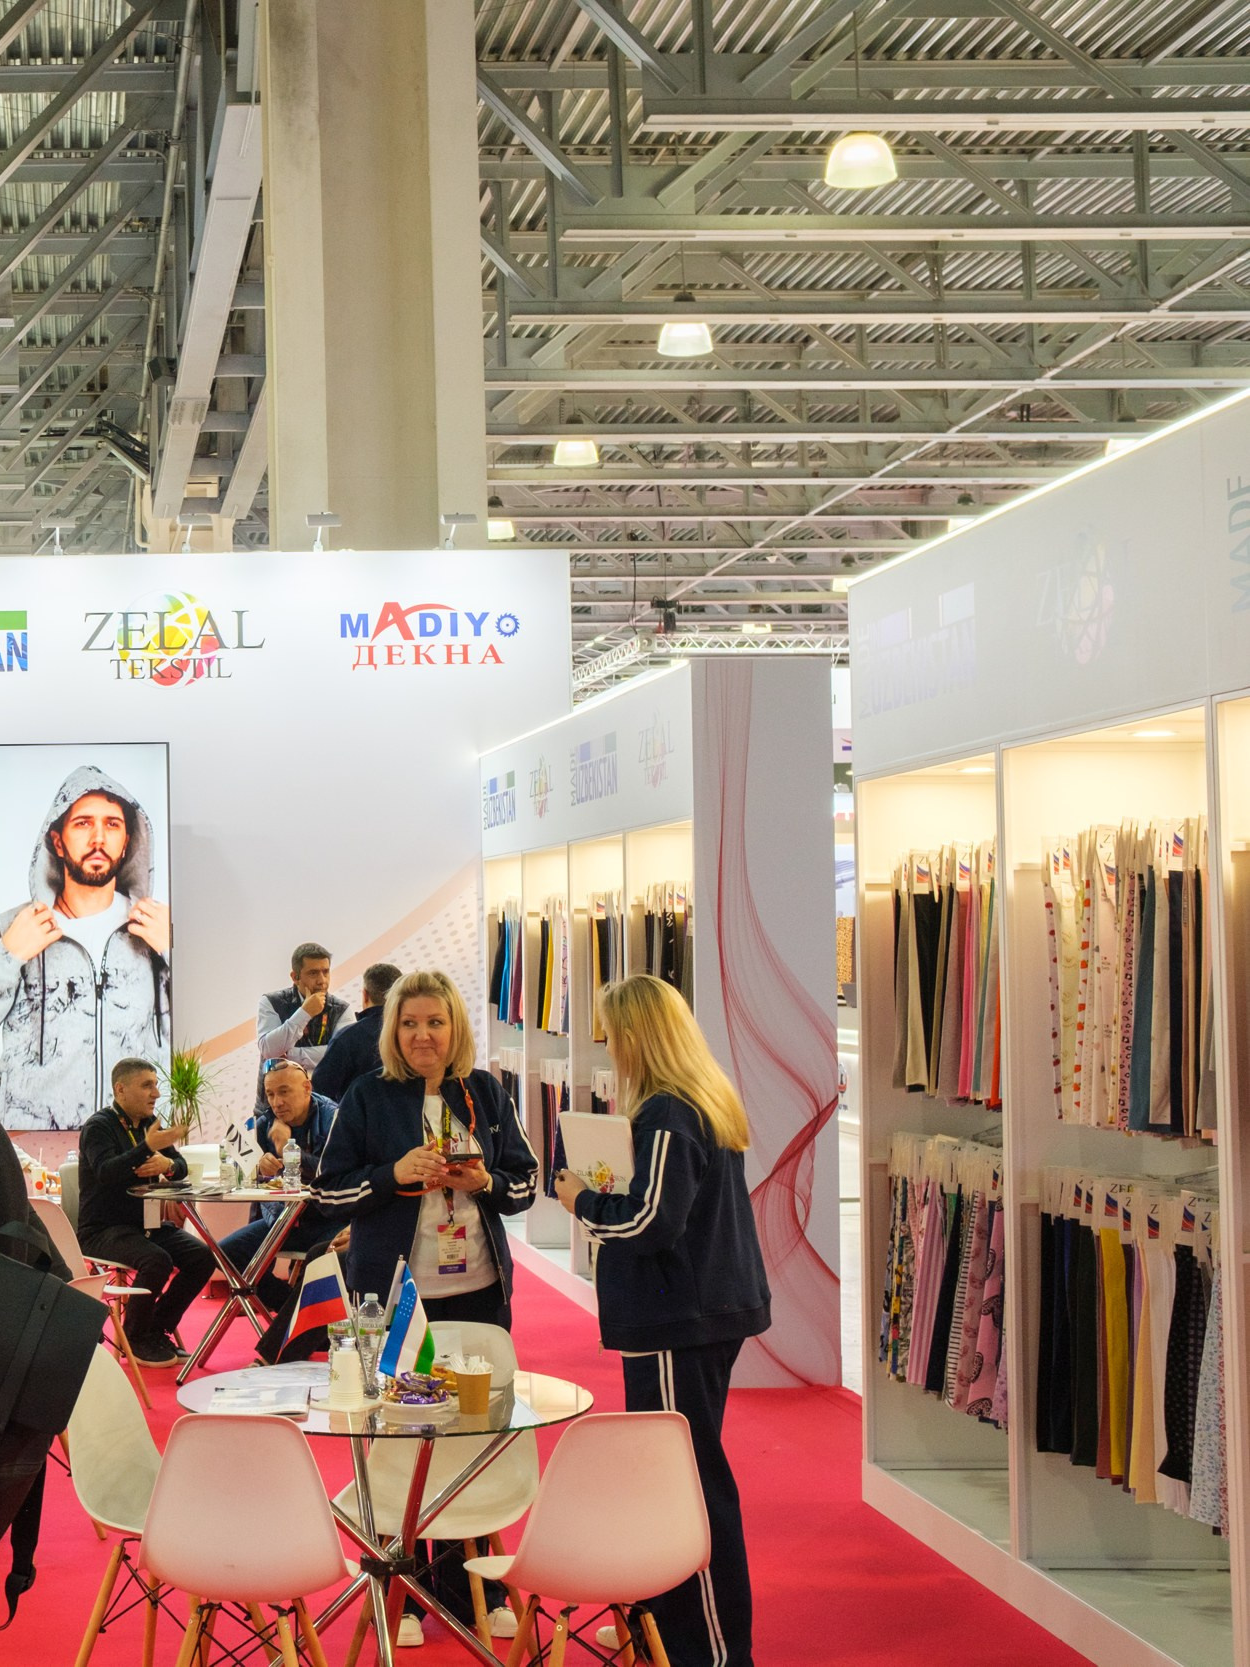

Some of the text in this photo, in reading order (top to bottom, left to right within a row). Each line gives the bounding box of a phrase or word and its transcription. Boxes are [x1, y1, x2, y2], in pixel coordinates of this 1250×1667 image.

[81, 610, 266, 652] ZELAL
[110, 656, 233, 680] TEKSTIL
[352, 644, 506, 671] ДЕКНА
[576, 754, 618, 805] UZBEKISTAN
